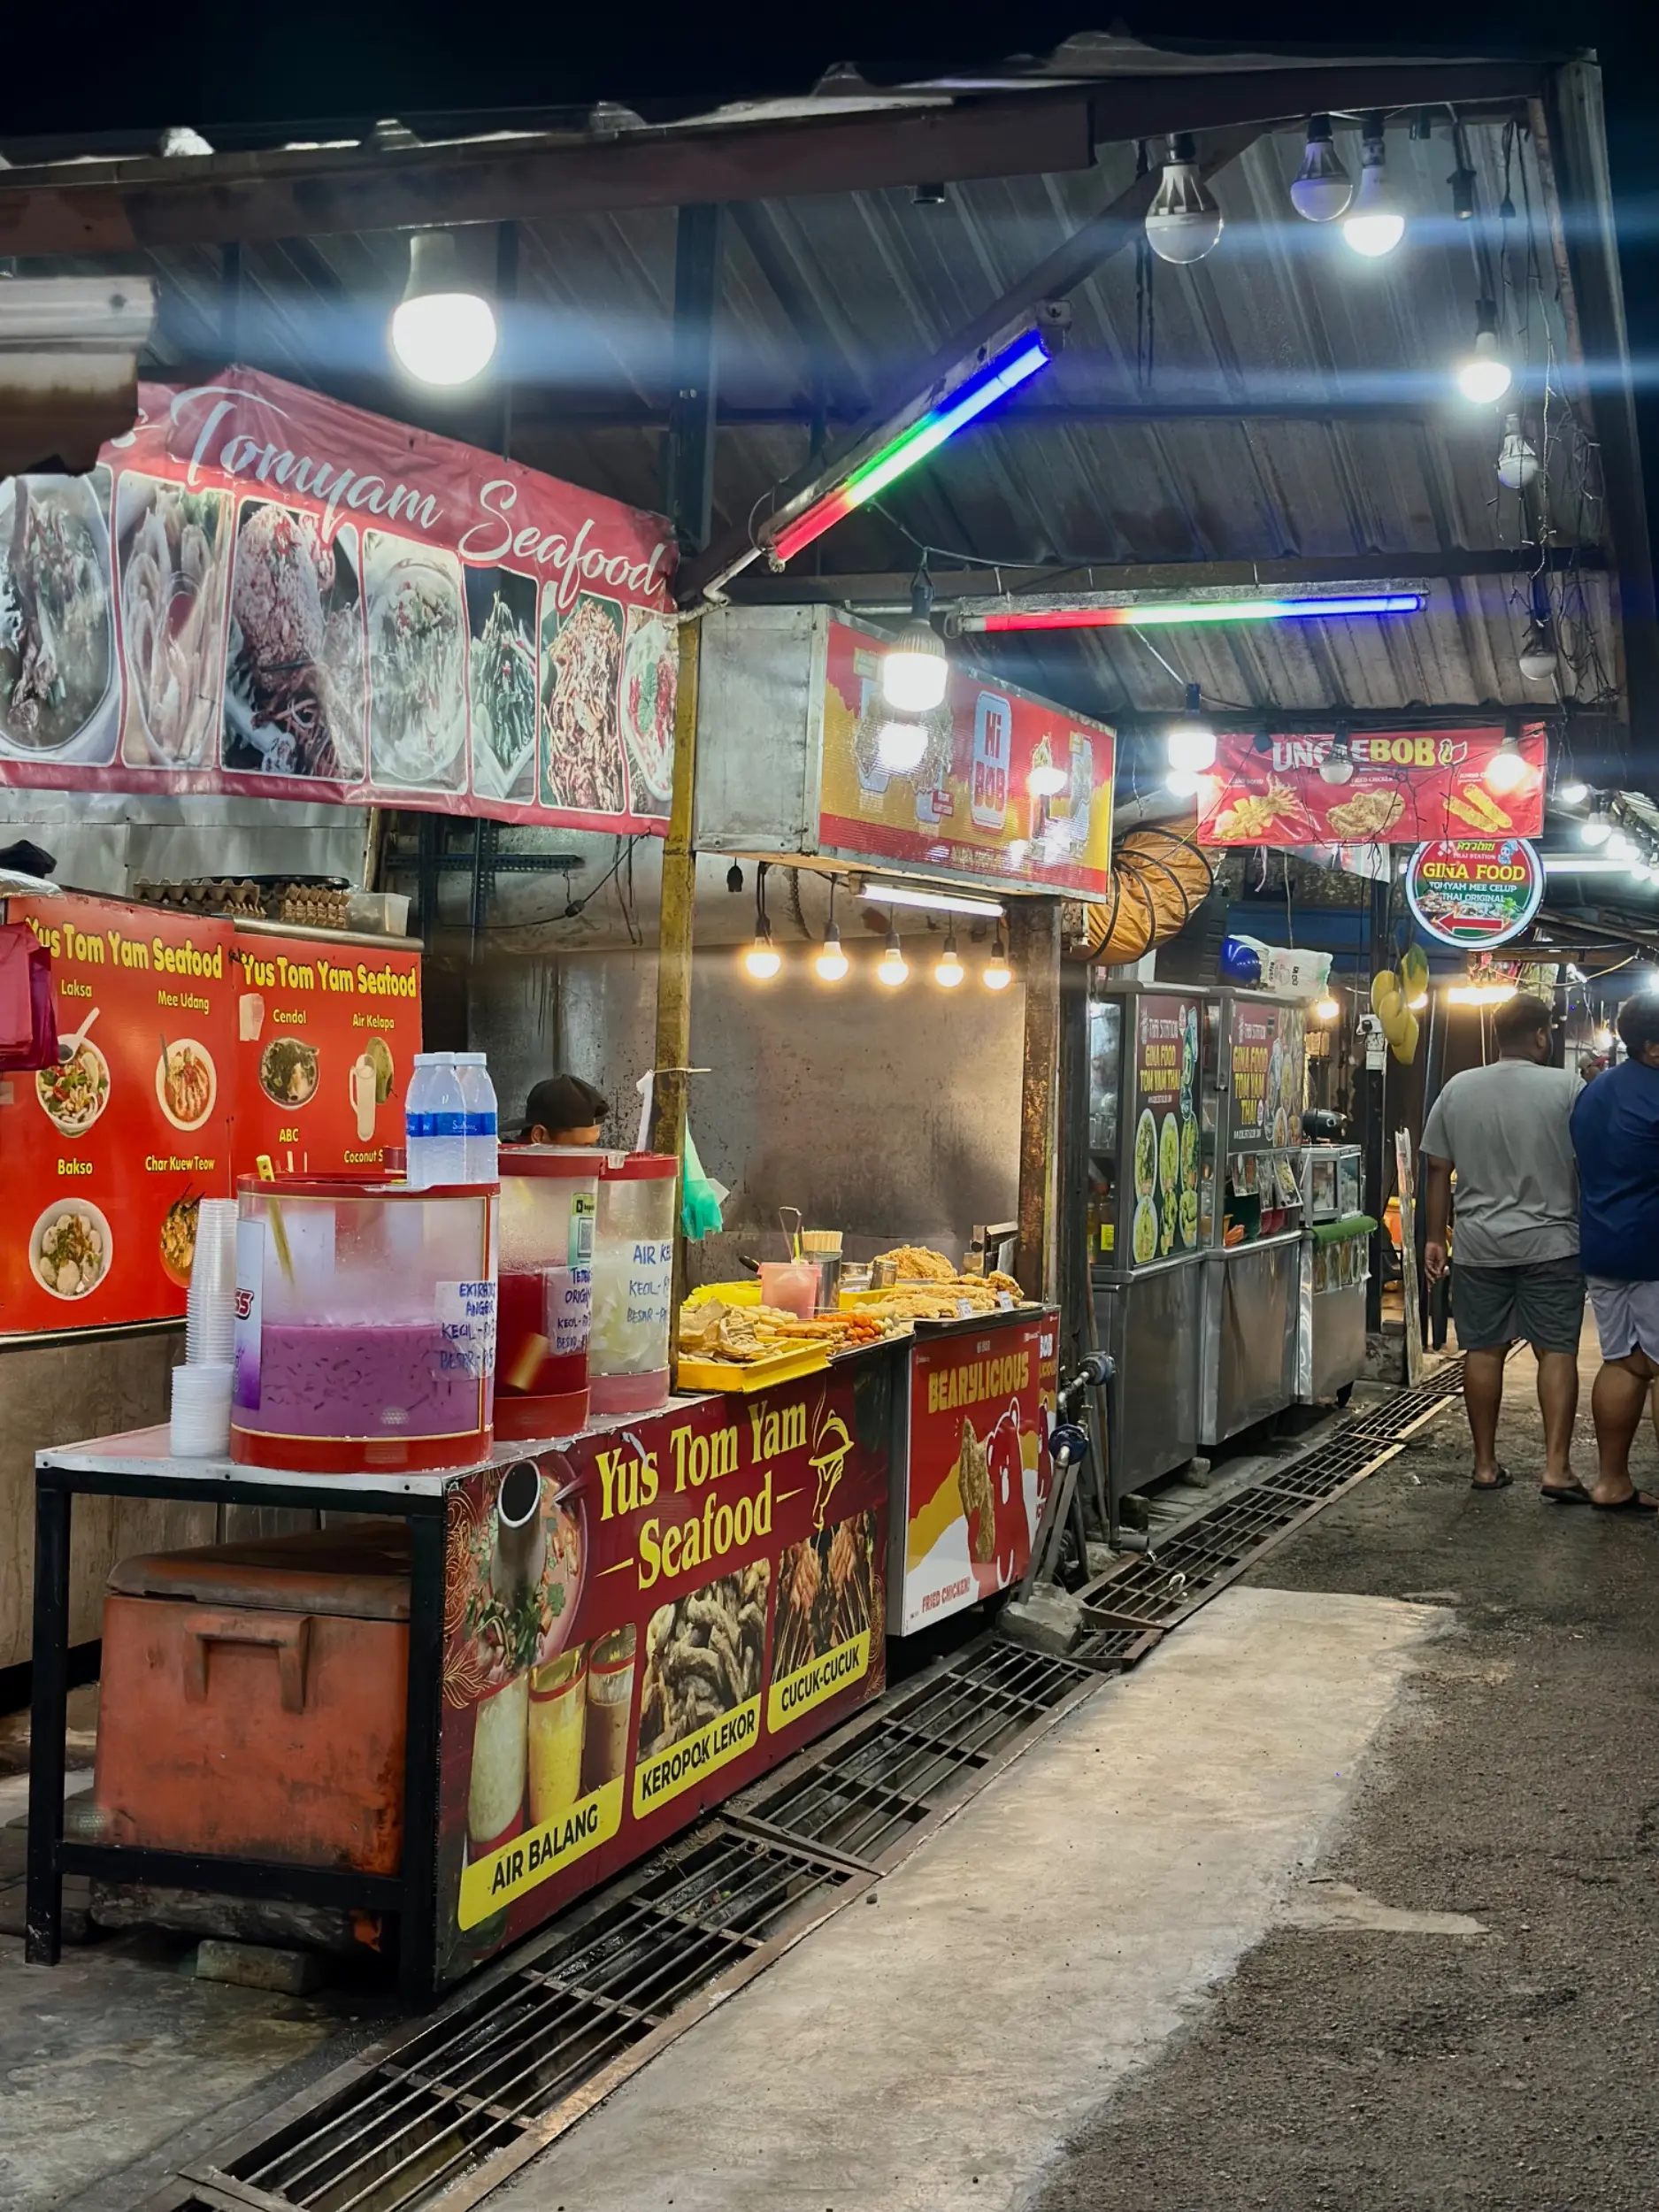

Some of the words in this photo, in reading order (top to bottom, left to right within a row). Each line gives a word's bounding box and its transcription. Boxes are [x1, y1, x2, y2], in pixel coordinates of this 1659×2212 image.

[170, 386, 443, 545] Tomyam
[458, 479, 666, 610] Seafood
[1272, 737, 1435, 772] UNCEBOB
[974, 761, 1006, 812] BOB
[1423, 862, 1470, 879] GINA
[1475, 864, 1526, 881] FOOD
[1429, 881, 1466, 891] TOMYAM
[1489, 884, 1517, 893] CELUP
[1442, 893, 1463, 902] THAI
[1464, 894, 1505, 902] ORIGINAL
[25, 916, 61, 958] Yus
[62, 923, 104, 964] Tom
[107, 929, 150, 970] Yam
[151, 936, 222, 979] Seafood
[240, 952, 275, 987] Yus
[276, 956, 314, 990] Tom
[317, 959, 354, 993] Yam
[356, 963, 417, 998] Seafood
[61, 979, 92, 997] Laksa
[157, 990, 178, 1007] Mee
[180, 992, 210, 1015] Udang
[273, 1009, 307, 1025] Cendol
[353, 1013, 365, 1027] Air
[366, 1014, 395, 1032] Kelapa
[279, 1128, 299, 1143] ABC
[58, 1157, 93, 1175] Bakso
[145, 1156, 168, 1171] Char
[169, 1156, 193, 1171] Kuew
[193, 1156, 215, 1171] Teow
[343, 1149, 377, 1164] Coconut
[634, 1245, 656, 1264] AIR
[928, 1351, 1029, 1414] BEARYLICIOUS
[595, 1448, 658, 1522] Yus
[670, 1425, 739, 1494] Tom
[748, 1400, 807, 1464] Yam
[638, 1470, 772, 1591] Seafood
[780, 1646, 861, 1712] CUCUK-CUCUK
[641, 1742, 710, 1801] KEROPOK
[712, 1708, 755, 1755] LEKOR
[492, 1849, 524, 1896] AIR
[528, 1802, 598, 1872] BALANG
